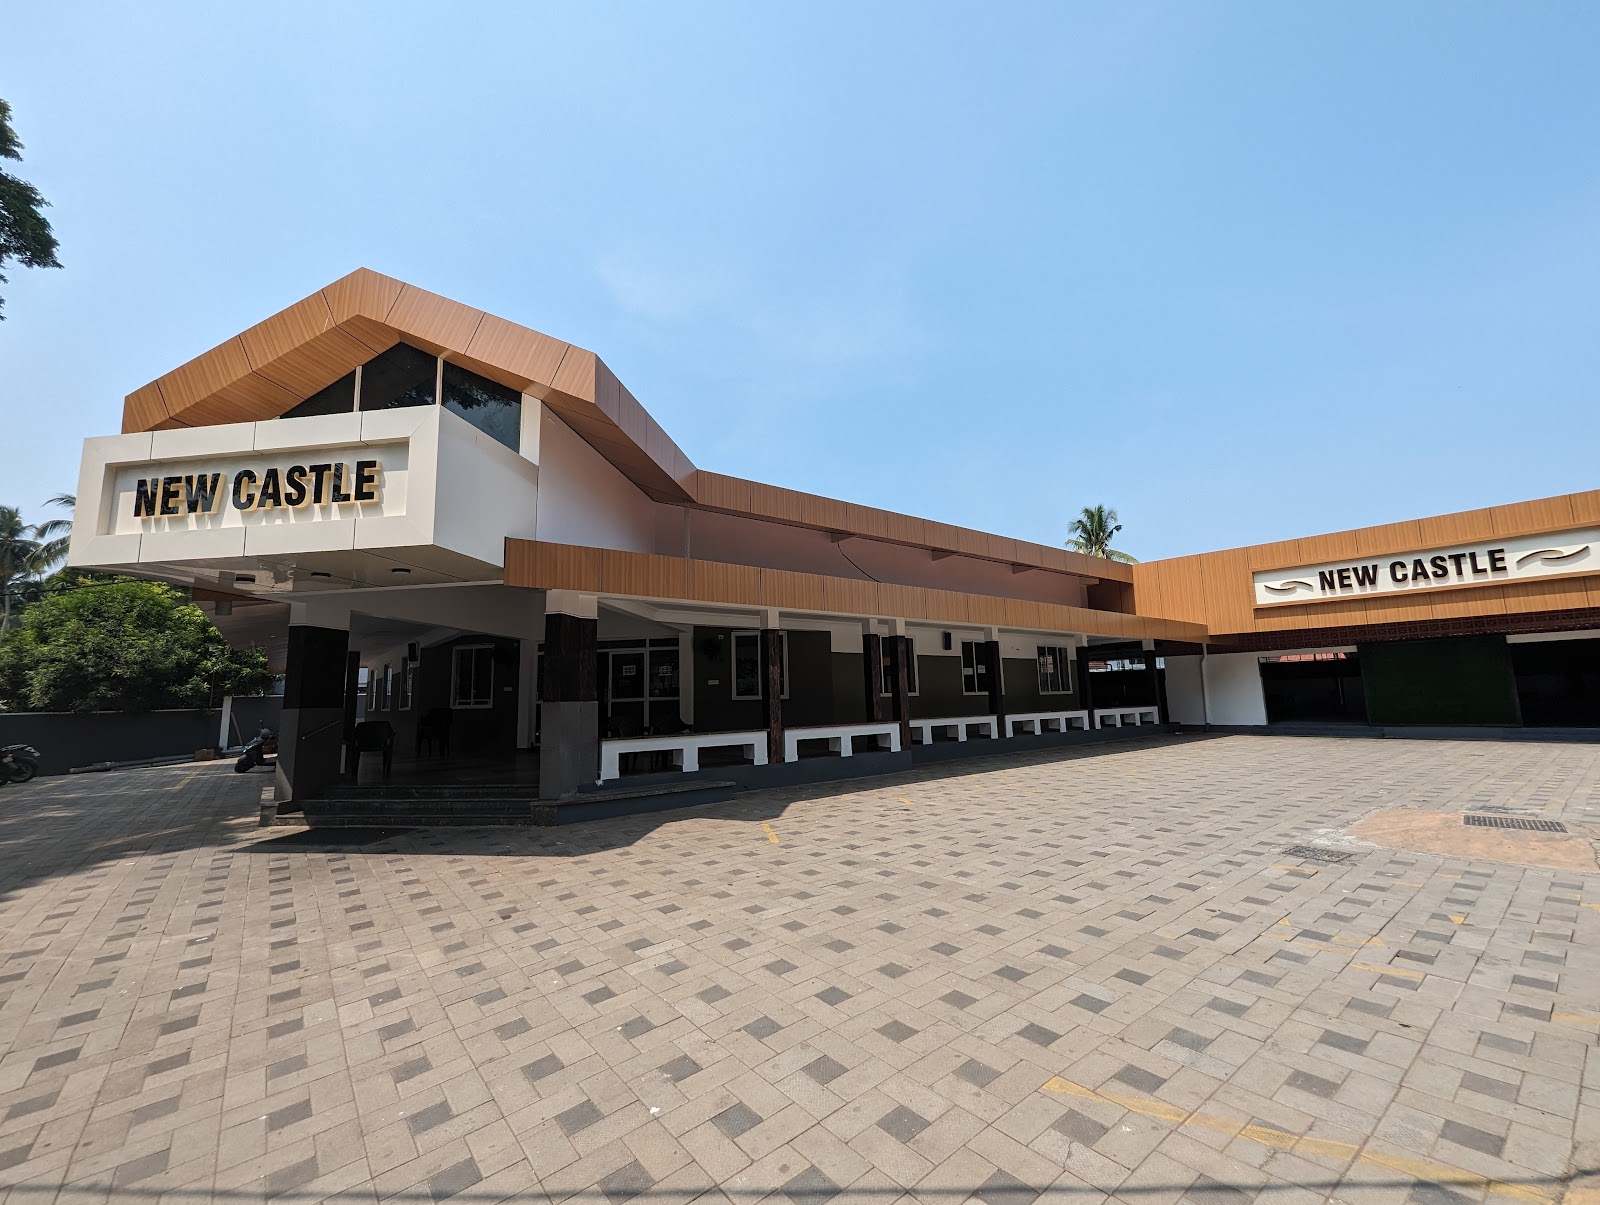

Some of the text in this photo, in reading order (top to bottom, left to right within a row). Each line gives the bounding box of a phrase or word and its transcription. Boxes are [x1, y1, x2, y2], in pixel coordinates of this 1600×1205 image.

[133, 460, 379, 517] NEW CASTLE
[1318, 548, 1507, 591] NEW CASTLE
